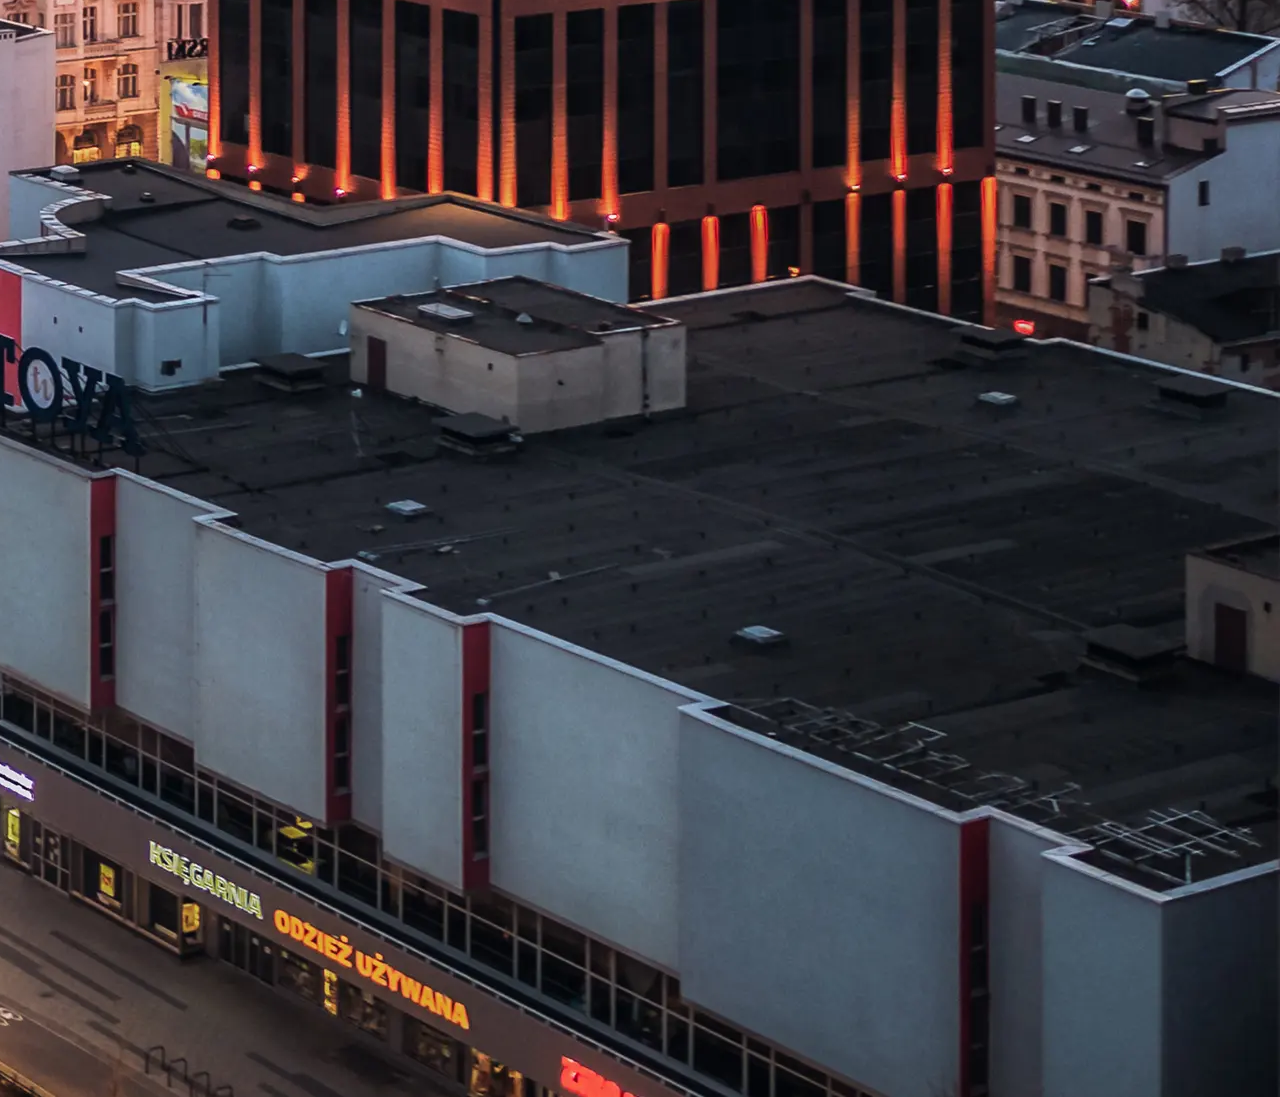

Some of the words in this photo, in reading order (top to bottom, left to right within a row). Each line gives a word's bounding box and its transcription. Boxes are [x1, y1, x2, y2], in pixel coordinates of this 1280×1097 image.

[149, 840, 264, 920] KSIĘGARNIA
[273, 909, 353, 968] ODZIEŻ
[355, 951, 470, 1030] UŻYWANA
